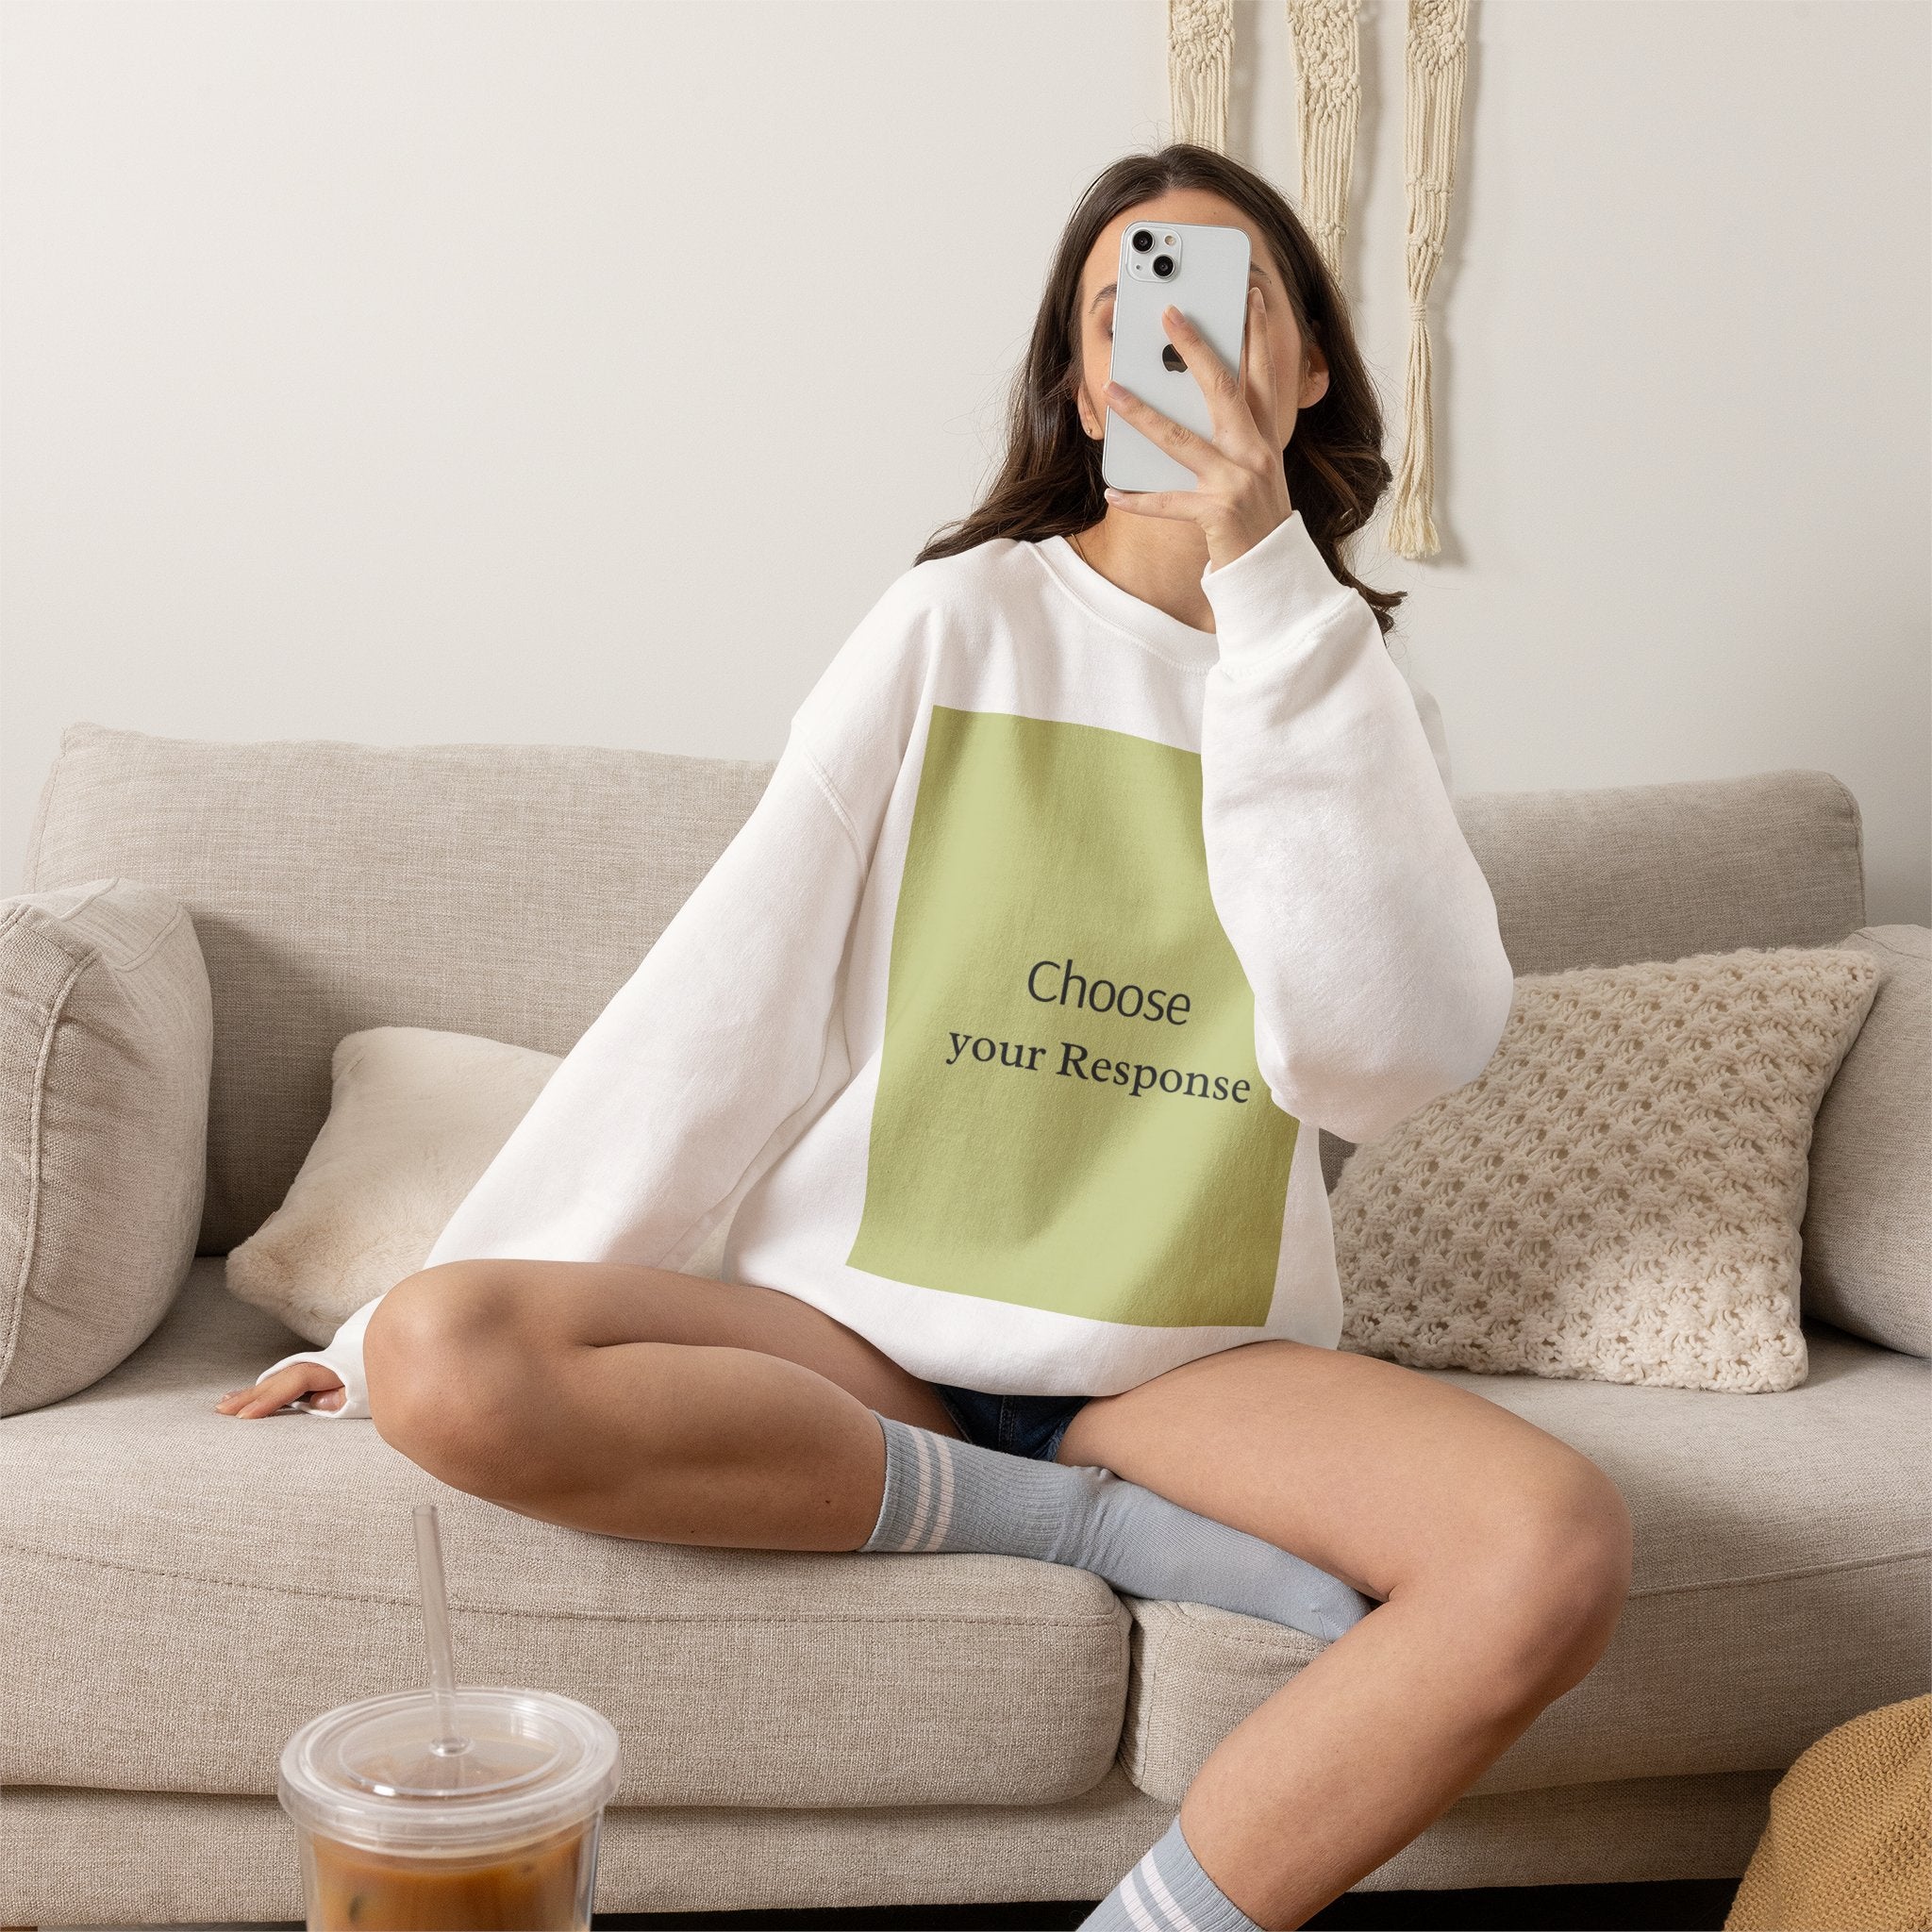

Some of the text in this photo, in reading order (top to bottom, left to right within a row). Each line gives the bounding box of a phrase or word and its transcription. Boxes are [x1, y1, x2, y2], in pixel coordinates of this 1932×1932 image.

[1027, 958, 1191, 1025] Choose
[944, 1031, 1252, 1104] your Response
